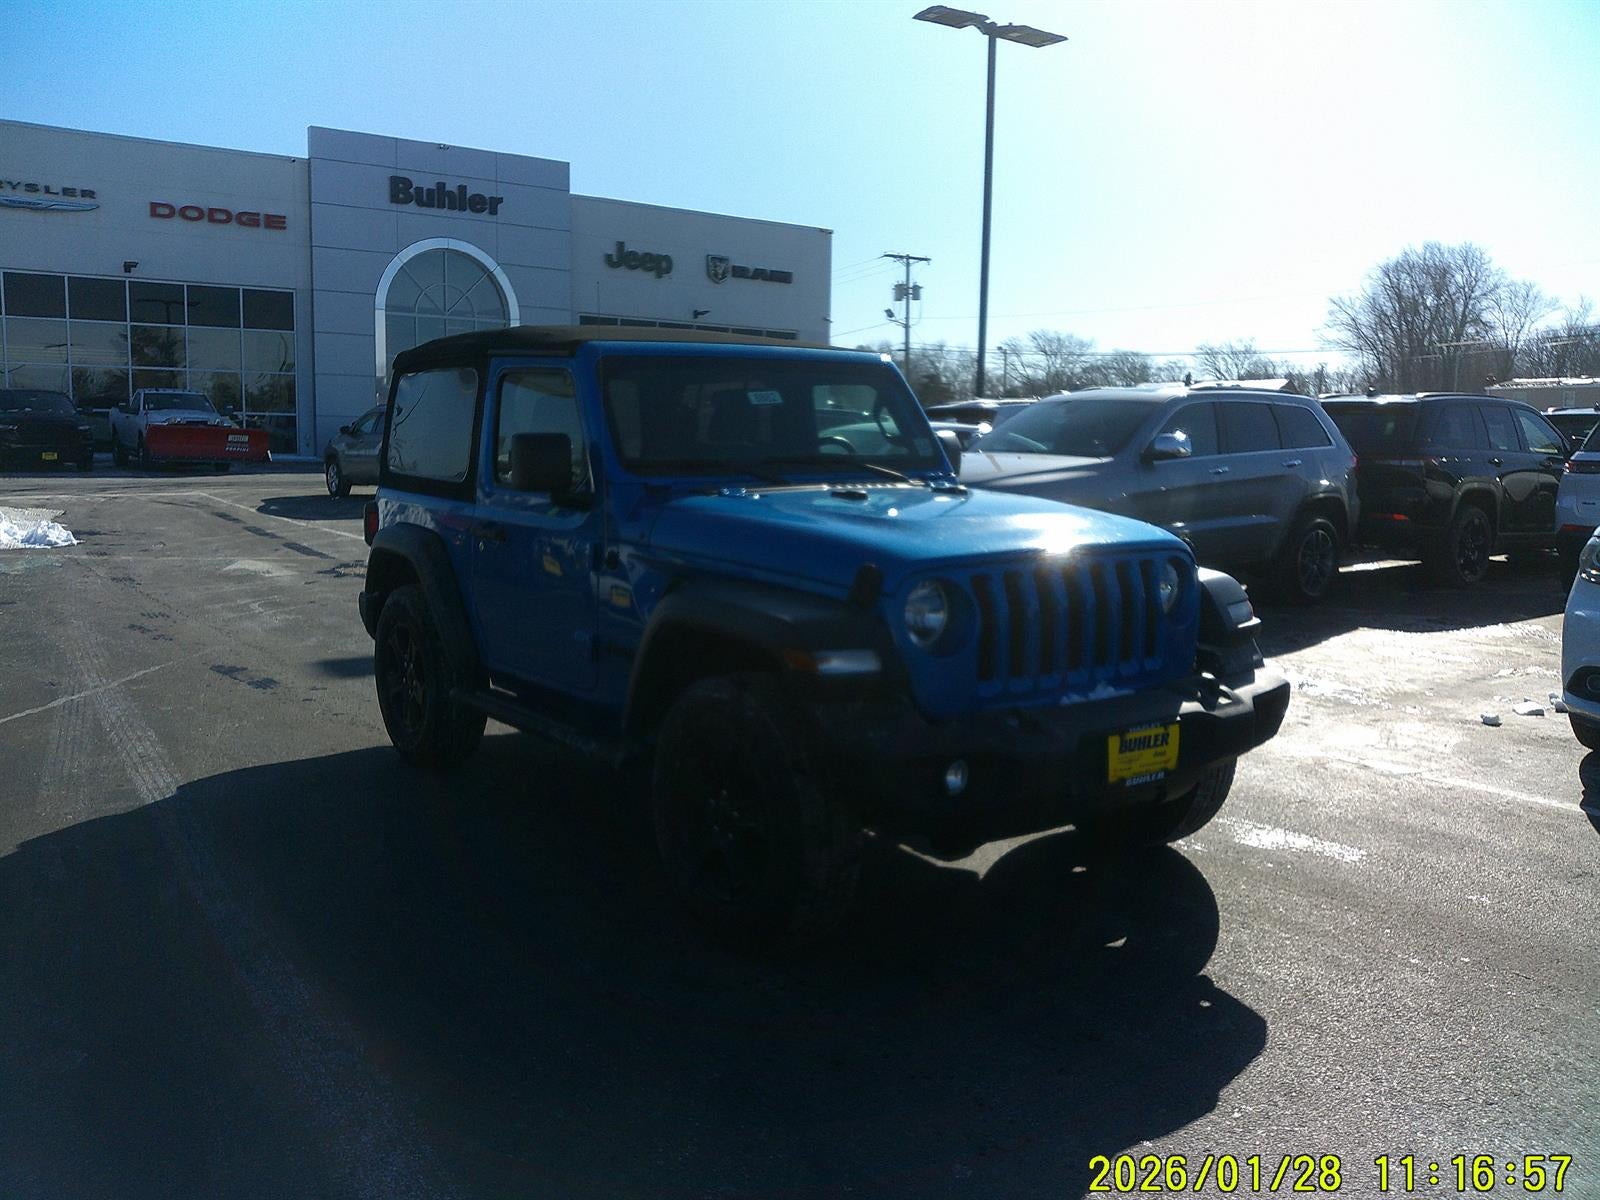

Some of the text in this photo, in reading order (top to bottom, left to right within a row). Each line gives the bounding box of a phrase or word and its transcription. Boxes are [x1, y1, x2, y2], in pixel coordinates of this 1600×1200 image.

[0, 180, 97, 200] YSLER
[389, 174, 504, 216] Buhler
[149, 201, 288, 231] DODGE
[604, 241, 673, 279] Jeep
[731, 264, 793, 284] RAM
